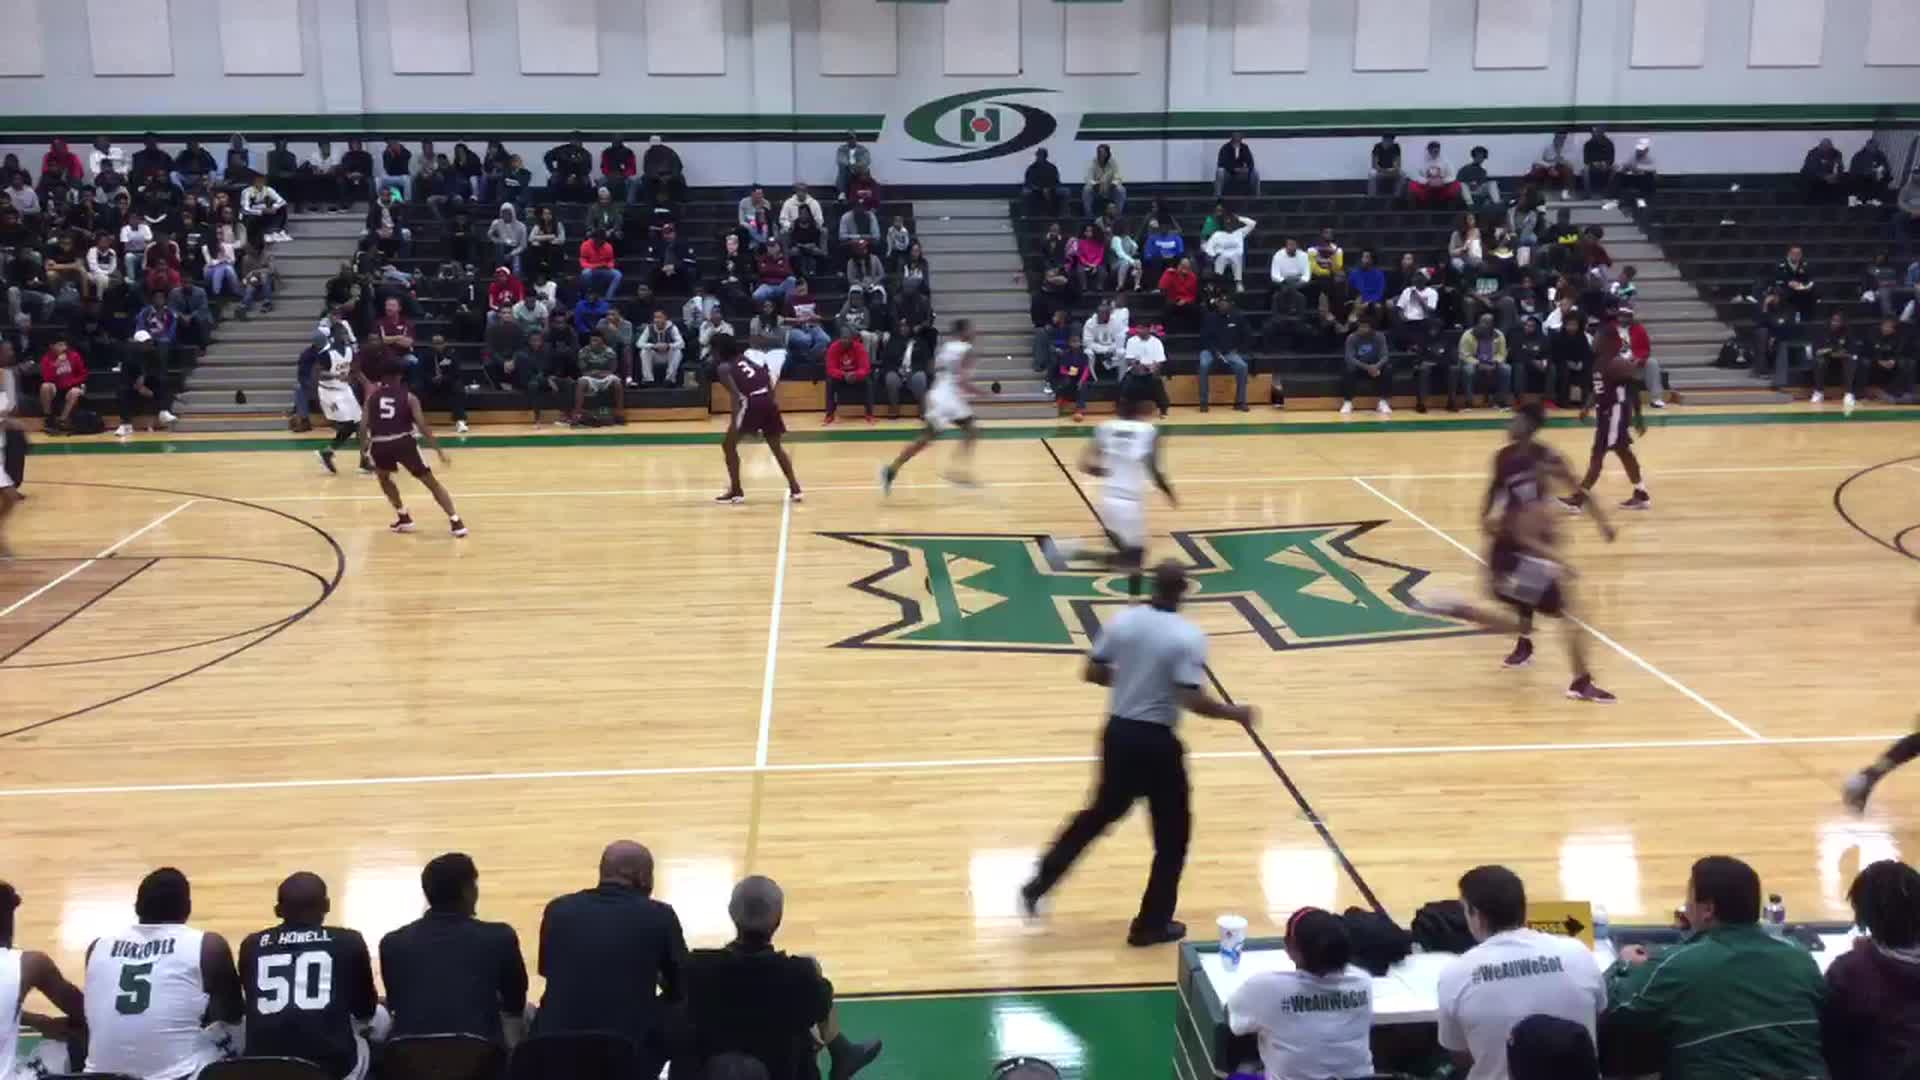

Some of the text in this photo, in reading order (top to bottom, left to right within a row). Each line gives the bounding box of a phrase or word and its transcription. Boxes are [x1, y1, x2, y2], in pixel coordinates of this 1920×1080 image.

[737, 361, 756, 378] 3
[379, 397, 396, 419] 5
[278, 929, 332, 945] HOWELL
[257, 950, 333, 1015] 50
[1471, 956, 1565, 985] #WeAllWeGot
[115, 962, 153, 1015] 5
